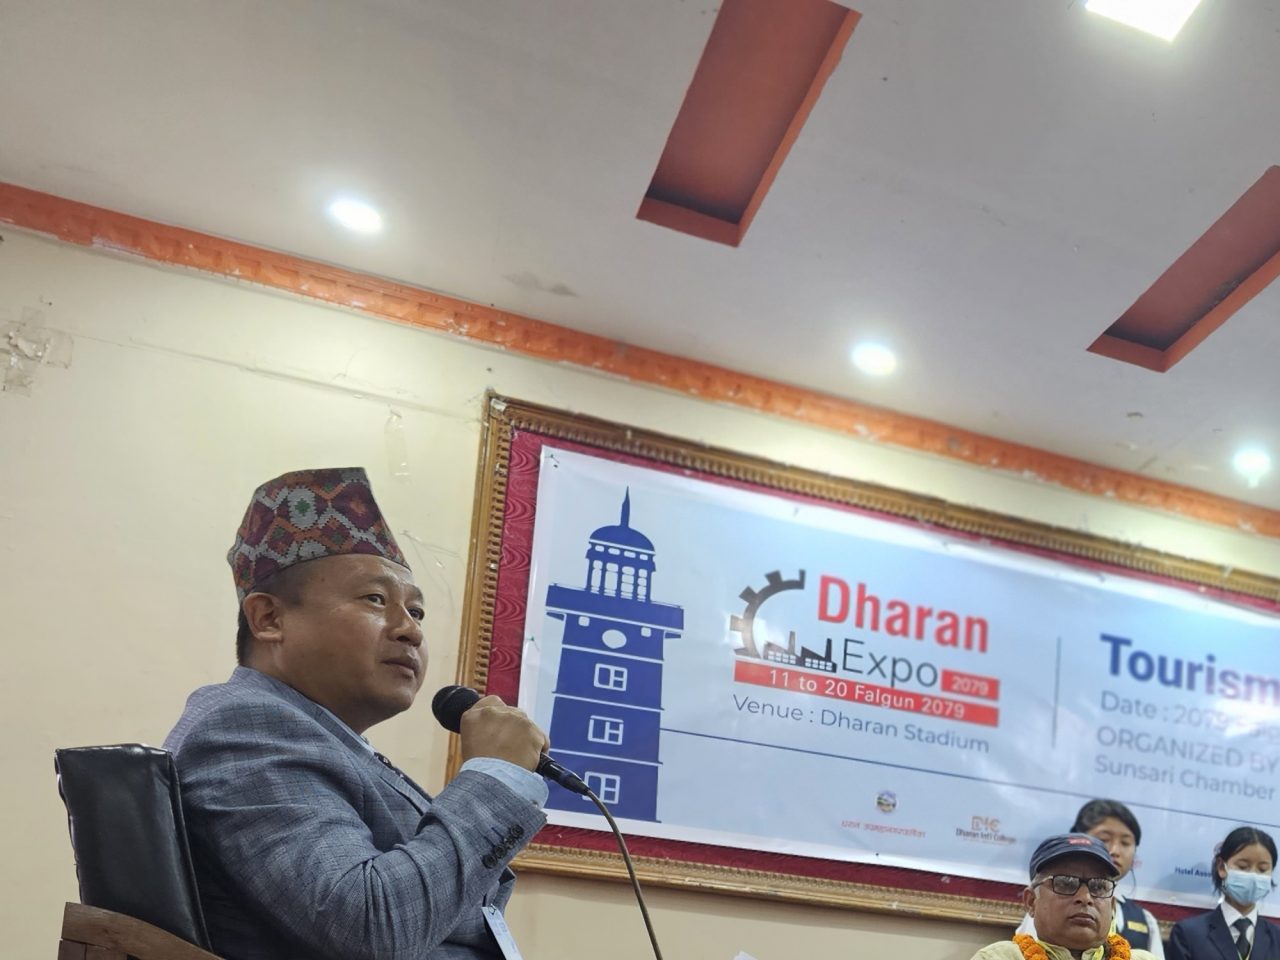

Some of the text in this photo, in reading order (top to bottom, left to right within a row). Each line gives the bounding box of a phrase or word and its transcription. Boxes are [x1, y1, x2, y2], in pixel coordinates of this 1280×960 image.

[818, 574, 990, 654] Dharan
[842, 638, 990, 698] Expo 2079
[769, 669, 966, 719] 11 to 20 Falgun 2079
[1101, 690, 1157, 720] Date
[733, 693, 804, 722] Venue
[820, 709, 899, 738] Dharan
[904, 724, 990, 753] Stadium
[1096, 725, 1243, 768] ORGANIZED
[1095, 755, 1174, 785] Sunsari
[1180, 769, 1275, 800] Chamber
